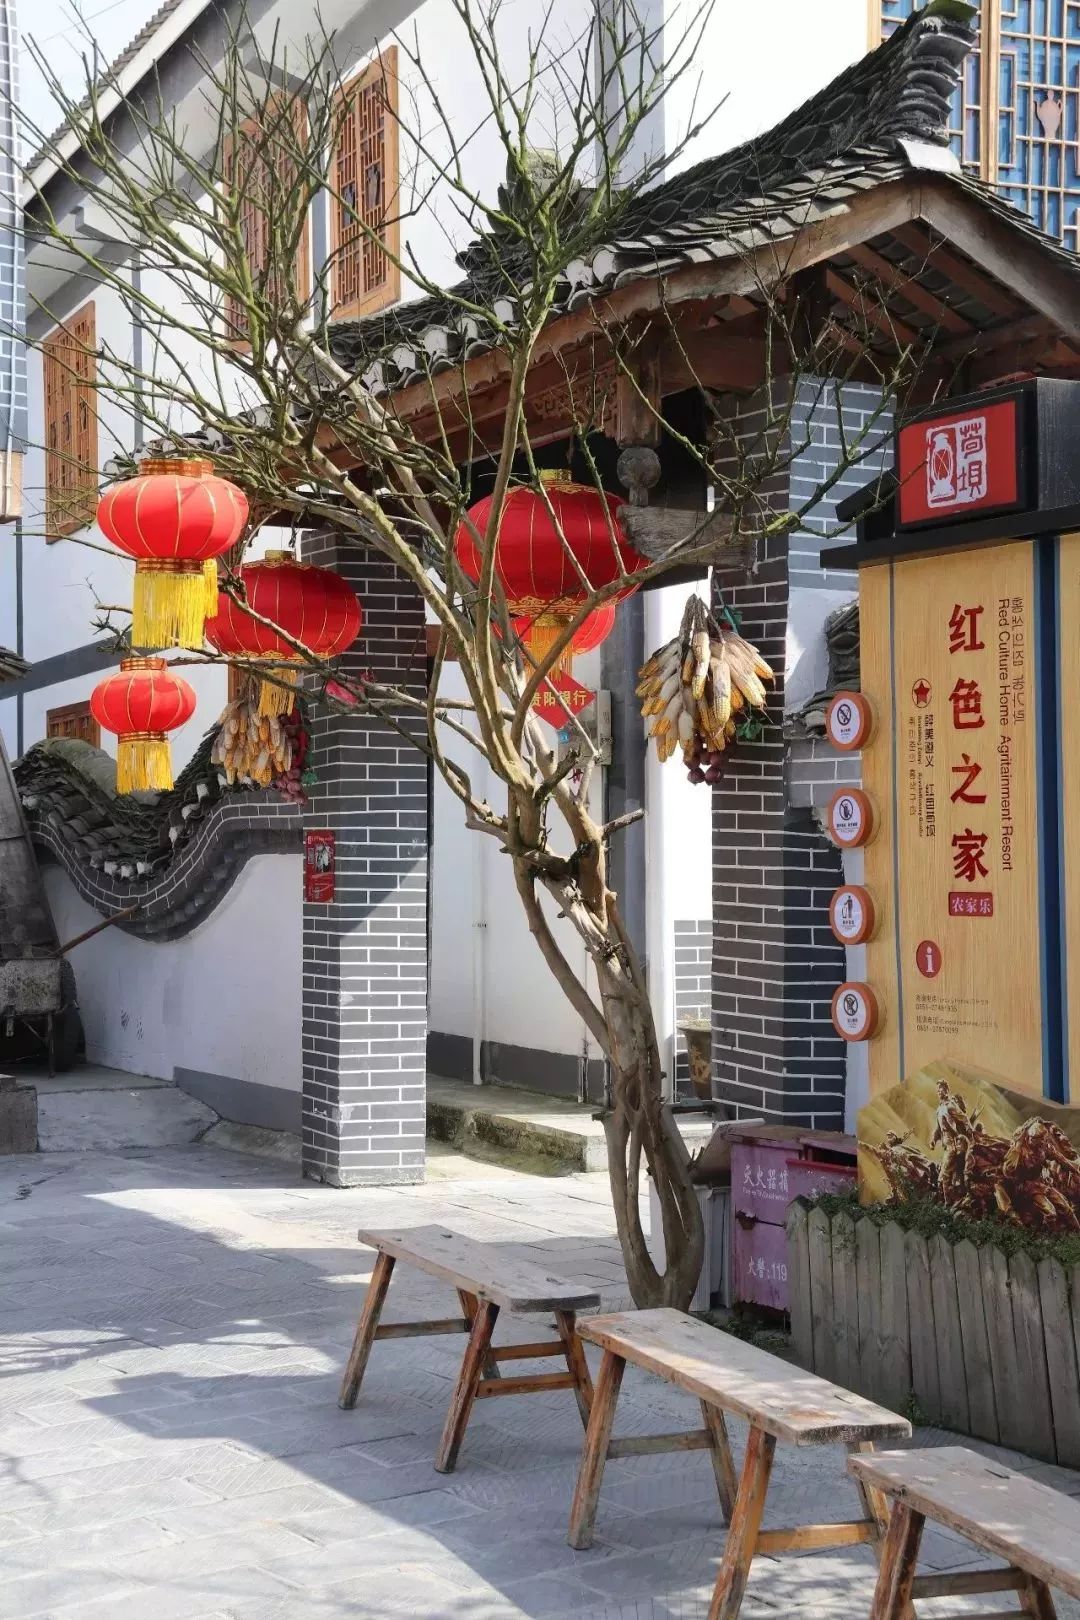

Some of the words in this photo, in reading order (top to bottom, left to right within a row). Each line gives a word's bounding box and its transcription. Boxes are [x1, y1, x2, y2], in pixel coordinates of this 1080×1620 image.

[998, 598, 1010, 627] Red
[998, 631, 1011, 681] Culture
[999, 685, 1011, 726] Home
[948, 603, 990, 882] 红色之家
[997, 735, 1013, 824] Agritainment
[1001, 825, 1014, 872] Resort
[952, 897, 991, 914] 农家乐
